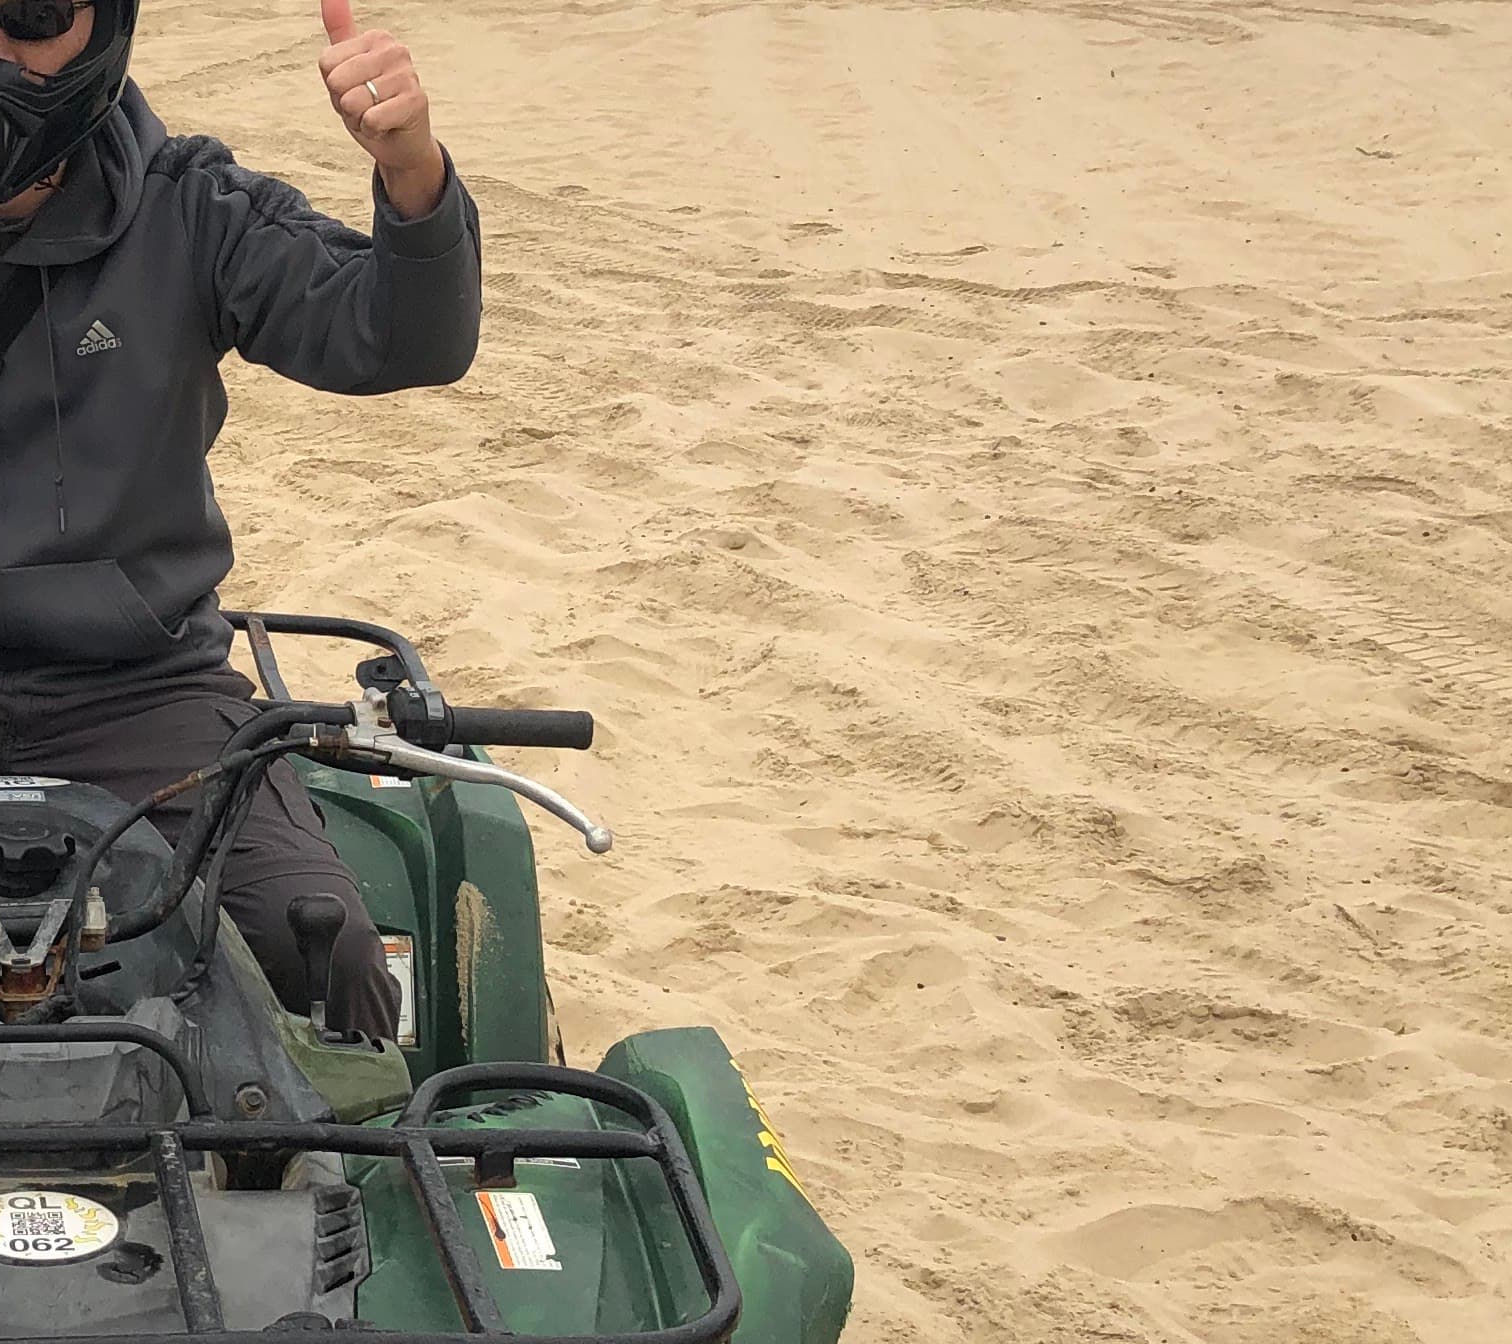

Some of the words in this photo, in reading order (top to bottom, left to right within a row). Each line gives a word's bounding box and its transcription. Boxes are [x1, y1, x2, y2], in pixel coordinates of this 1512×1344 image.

[76, 337, 122, 356] adidas
[7, 1196, 62, 1210] QL
[9, 1237, 75, 1252] 062
